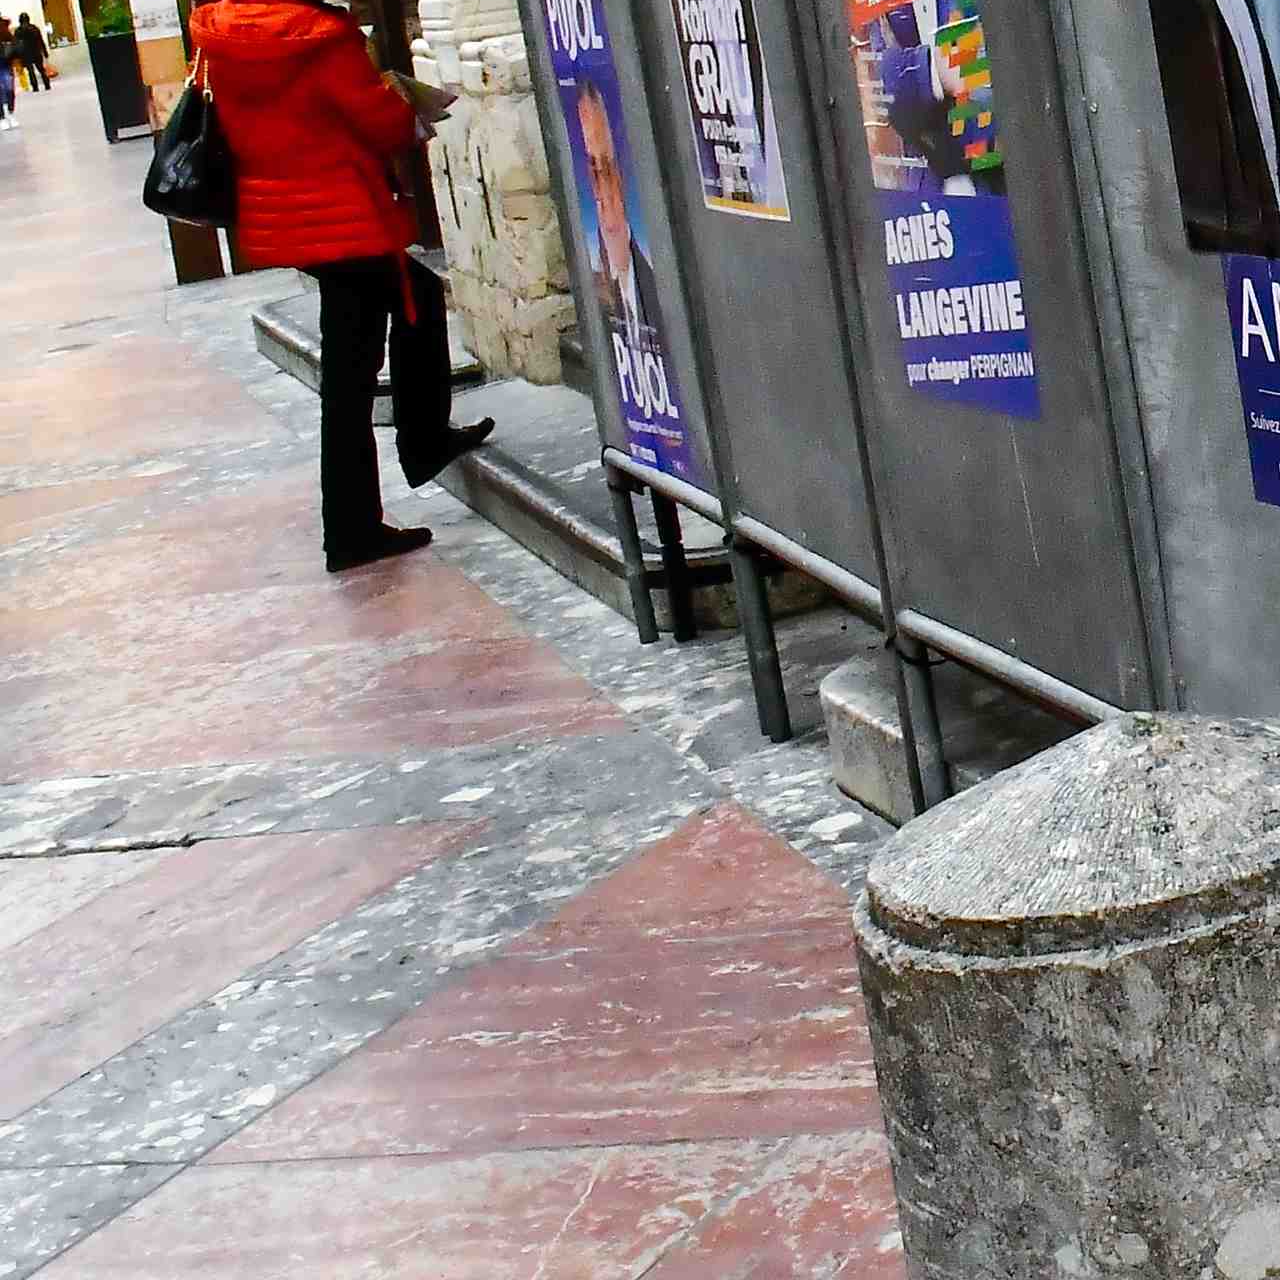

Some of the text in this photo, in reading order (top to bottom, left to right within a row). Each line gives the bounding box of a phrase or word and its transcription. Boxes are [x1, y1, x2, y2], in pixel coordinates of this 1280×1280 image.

[885, 201, 954, 265] AGNÈS
[897, 280, 1026, 338] LANGEVINE
[612, 332, 680, 418] PUJOL
[970, 352, 1034, 380] PERPIGNAN
[1250, 411, 1280, 434] Suivez
